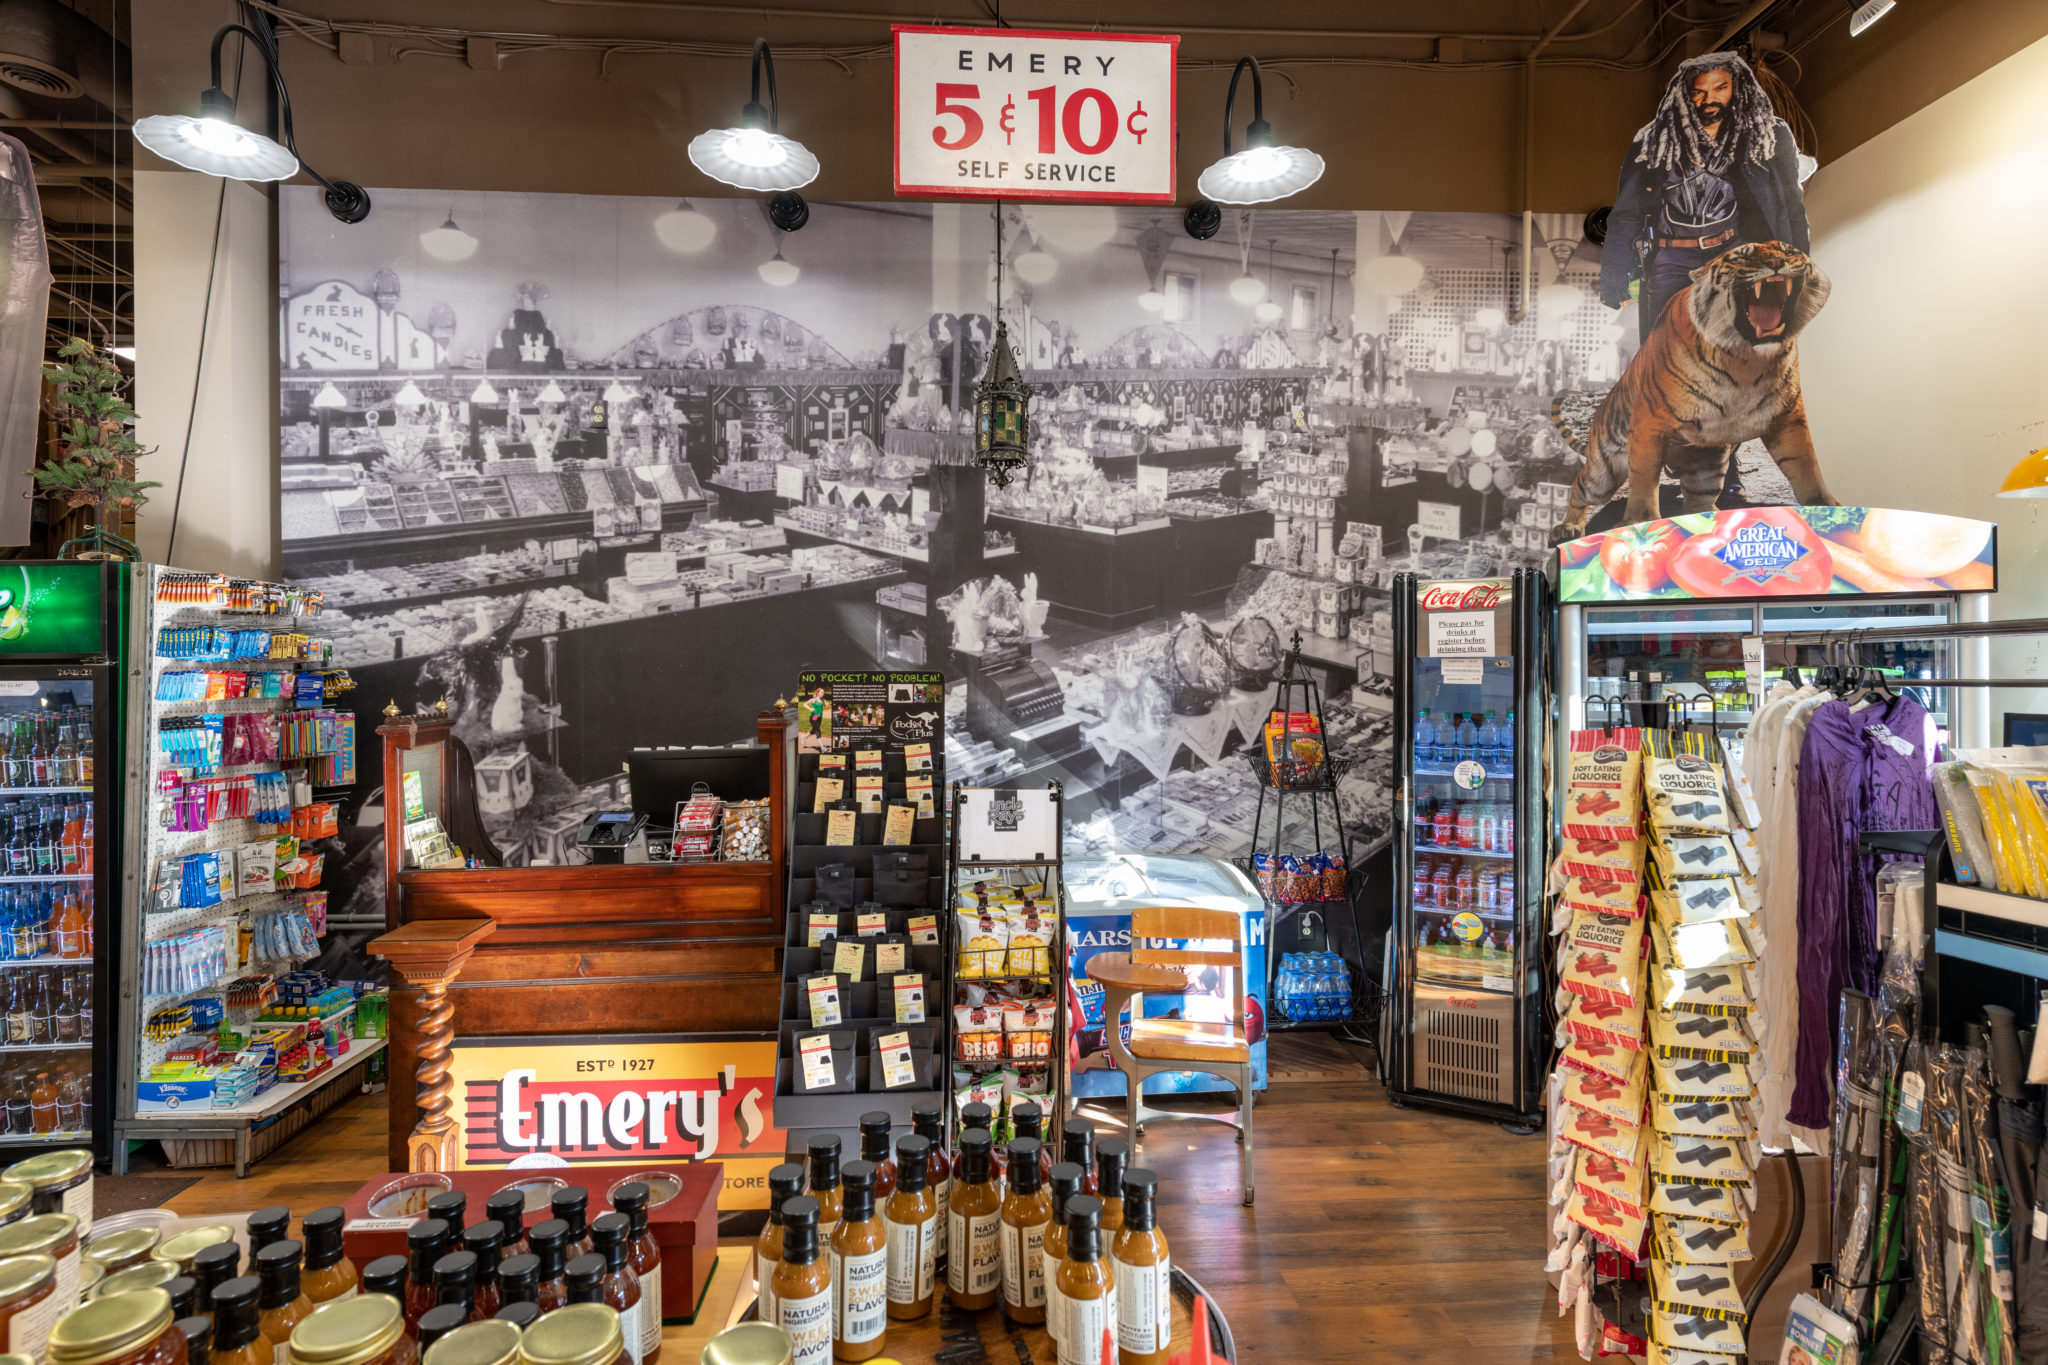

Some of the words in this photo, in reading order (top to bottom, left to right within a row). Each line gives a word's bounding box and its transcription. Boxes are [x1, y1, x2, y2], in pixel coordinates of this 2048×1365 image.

[958, 50, 1115, 76] EMERY
[957, 160, 1010, 179] SELF
[1024, 163, 1117, 183] SERVICE
[303, 304, 364, 318] FRESH
[296, 321, 373, 361] CANDIES
[1736, 526, 1787, 543] GREAT
[1723, 541, 1799, 563] AMERICAN
[1744, 558, 1778, 567] DELI
[802, 674, 816, 683] NO
[820, 673, 866, 683] POCKET?
[871, 674, 886, 683] NO
[890, 673, 940, 683] PROBLEM!
[895, 719, 923, 729] Pocket
[914, 728, 934, 737] Plus
[1574, 765, 1591, 773] SOFT
[1593, 765, 1622, 773] EATING
[1572, 772, 1622, 781] LIQUORICE
[1659, 773, 1680, 781] SOFT
[1683, 774, 1716, 782] EATING
[1660, 780, 1717, 790] LIQUORICE
[1945, 810, 1962, 853] SUPERMAN
[1576, 930, 1623, 945] LIQUORICE
[1597, 926, 1625, 937] EATING
[962, 1041, 999, 1057] BBQ
[1012, 1041, 1049, 1058] BBQ
[171, 1053, 195, 1062] HALLS
[622, 1058, 655, 1072] 1927
[158, 1083, 188, 1093] Kleenex
[499, 1063, 765, 1160] Emery's
[722, 1176, 765, 1190] TORE
[792, 1319, 829, 1341] WEET
